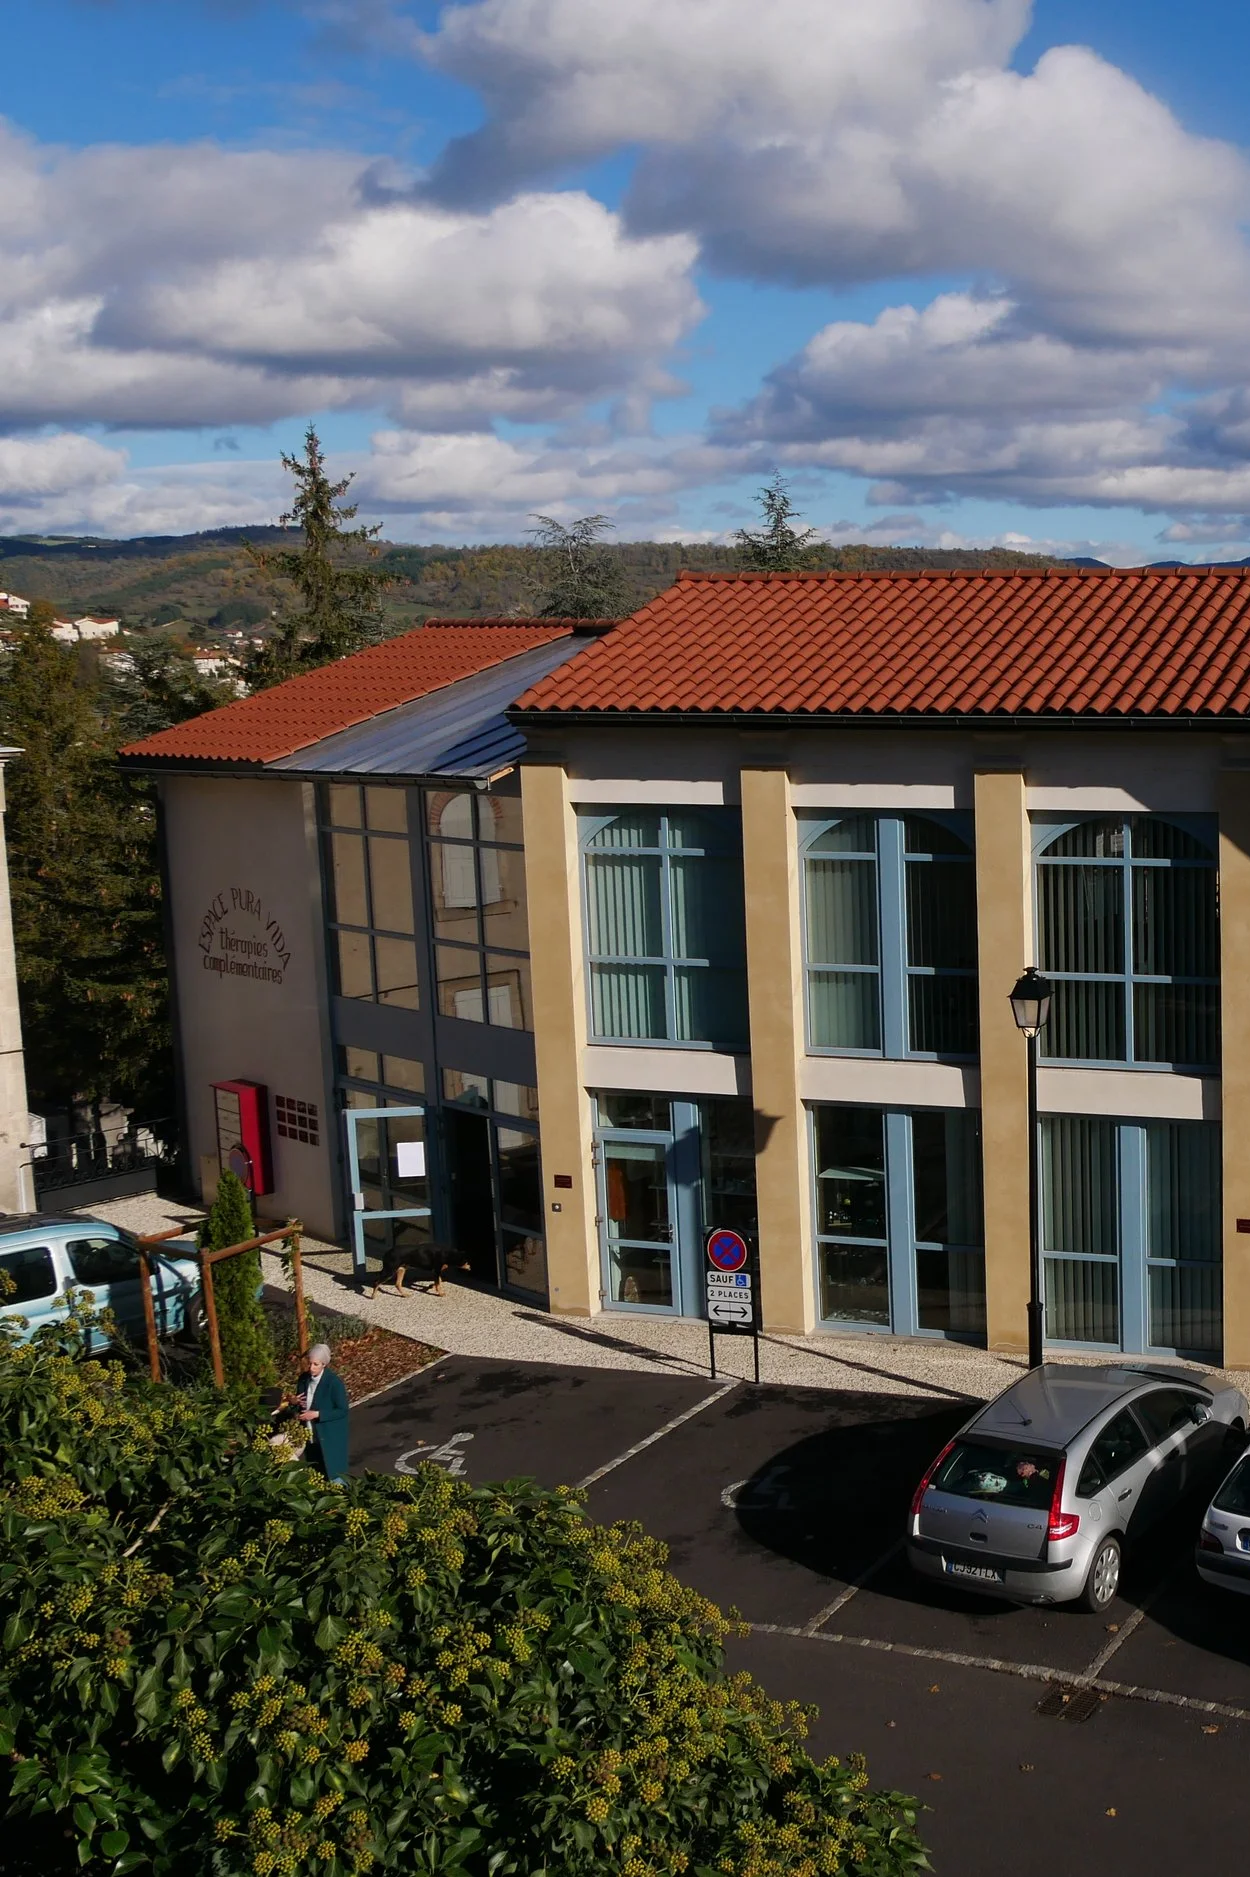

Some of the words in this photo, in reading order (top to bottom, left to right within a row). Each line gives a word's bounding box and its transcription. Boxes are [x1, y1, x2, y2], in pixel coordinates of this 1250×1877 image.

[198, 892, 229, 954] ESPACE
[230, 887, 261, 921] PURA
[266, 911, 291, 972] VIDA
[219, 926, 268, 959] thérapies
[709, 1274, 734, 1284] SAUF
[709, 1289, 715, 1297] 2
[717, 1289, 749, 1300] PLACES
